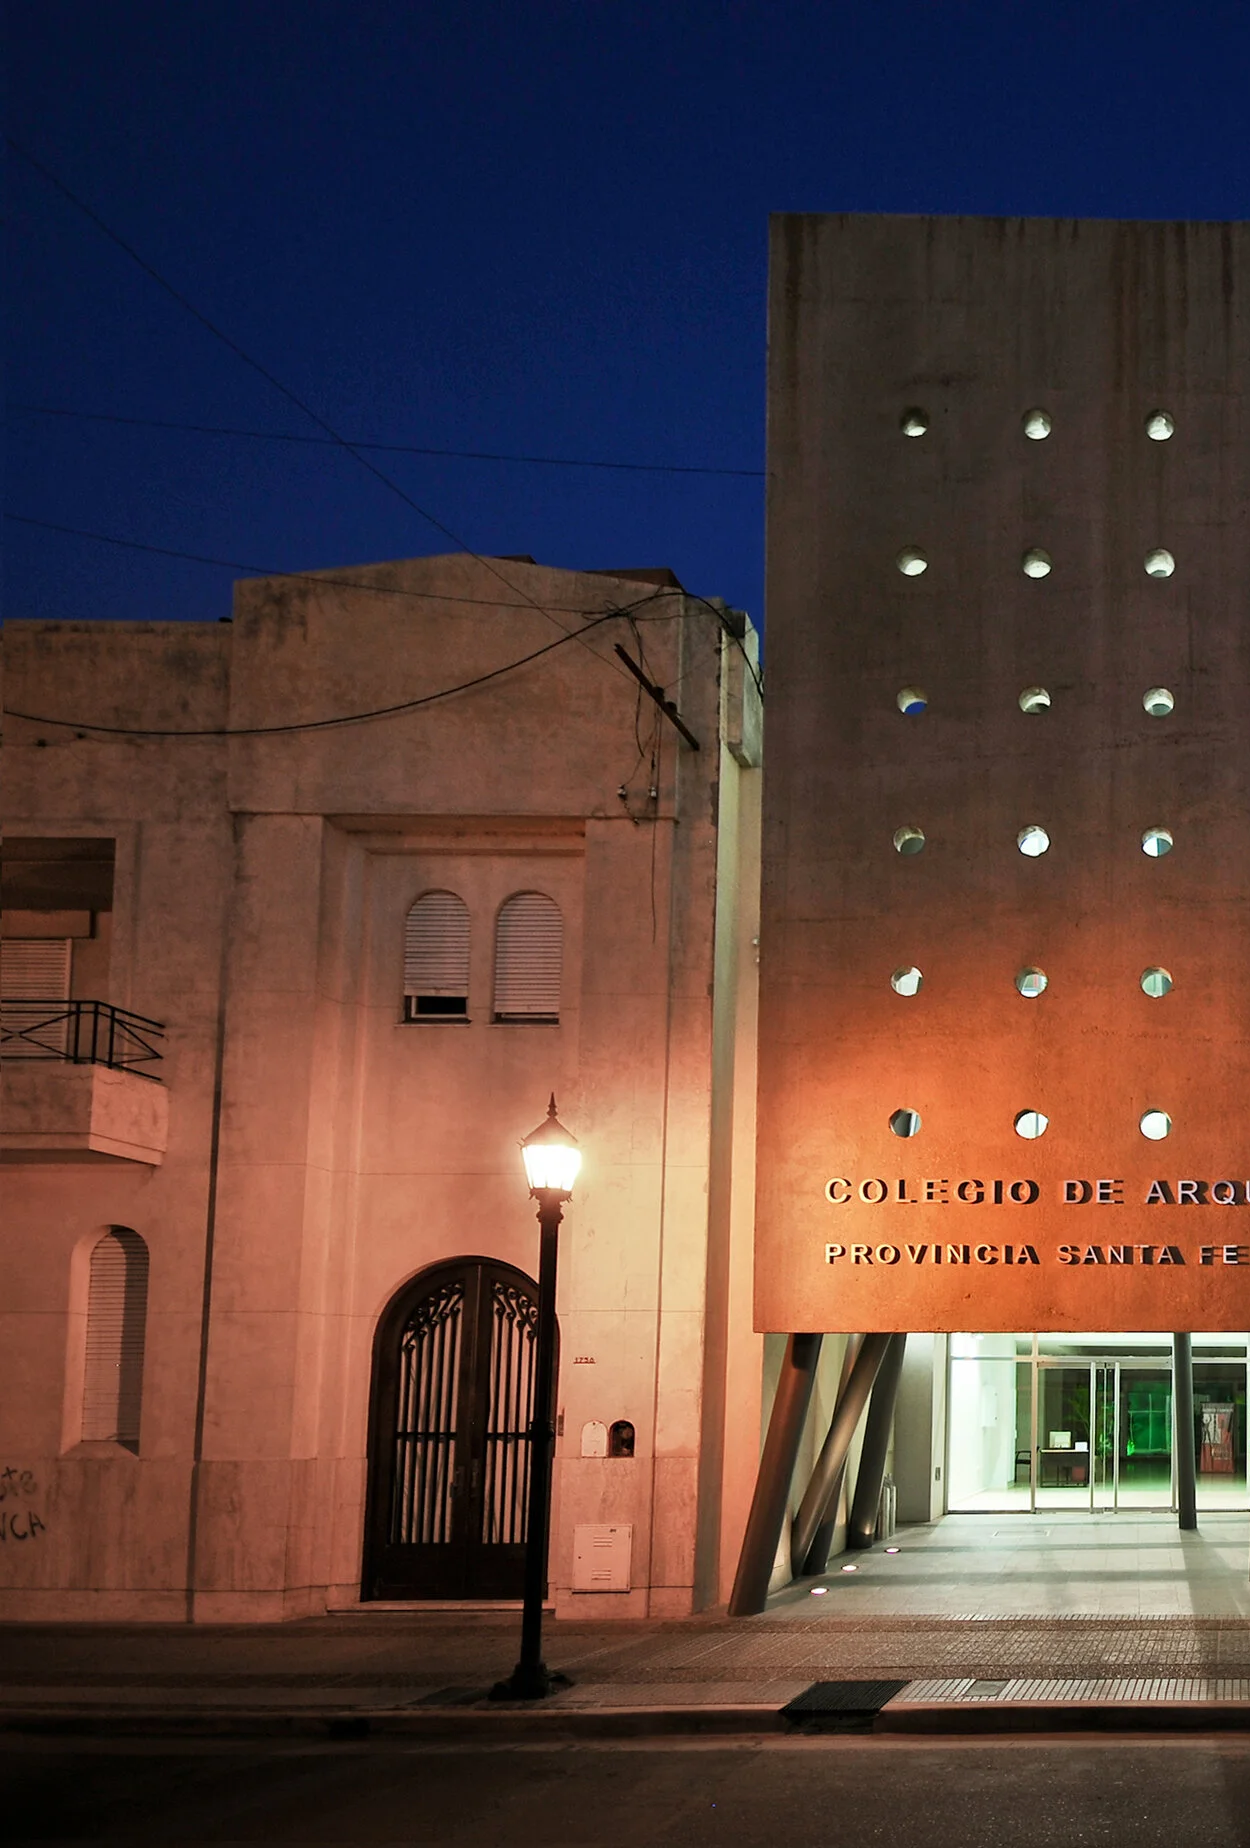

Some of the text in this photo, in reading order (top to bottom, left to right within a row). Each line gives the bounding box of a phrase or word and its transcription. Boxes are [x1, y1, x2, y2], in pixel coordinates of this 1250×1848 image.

[825, 1177, 1037, 1204] COLEGIO
[1063, 1179, 1117, 1204] DE
[825, 1243, 1038, 1264] PROVINCIA
[1057, 1245, 1176, 1265] SANTA
[1199, 1245, 1240, 1264] FE
